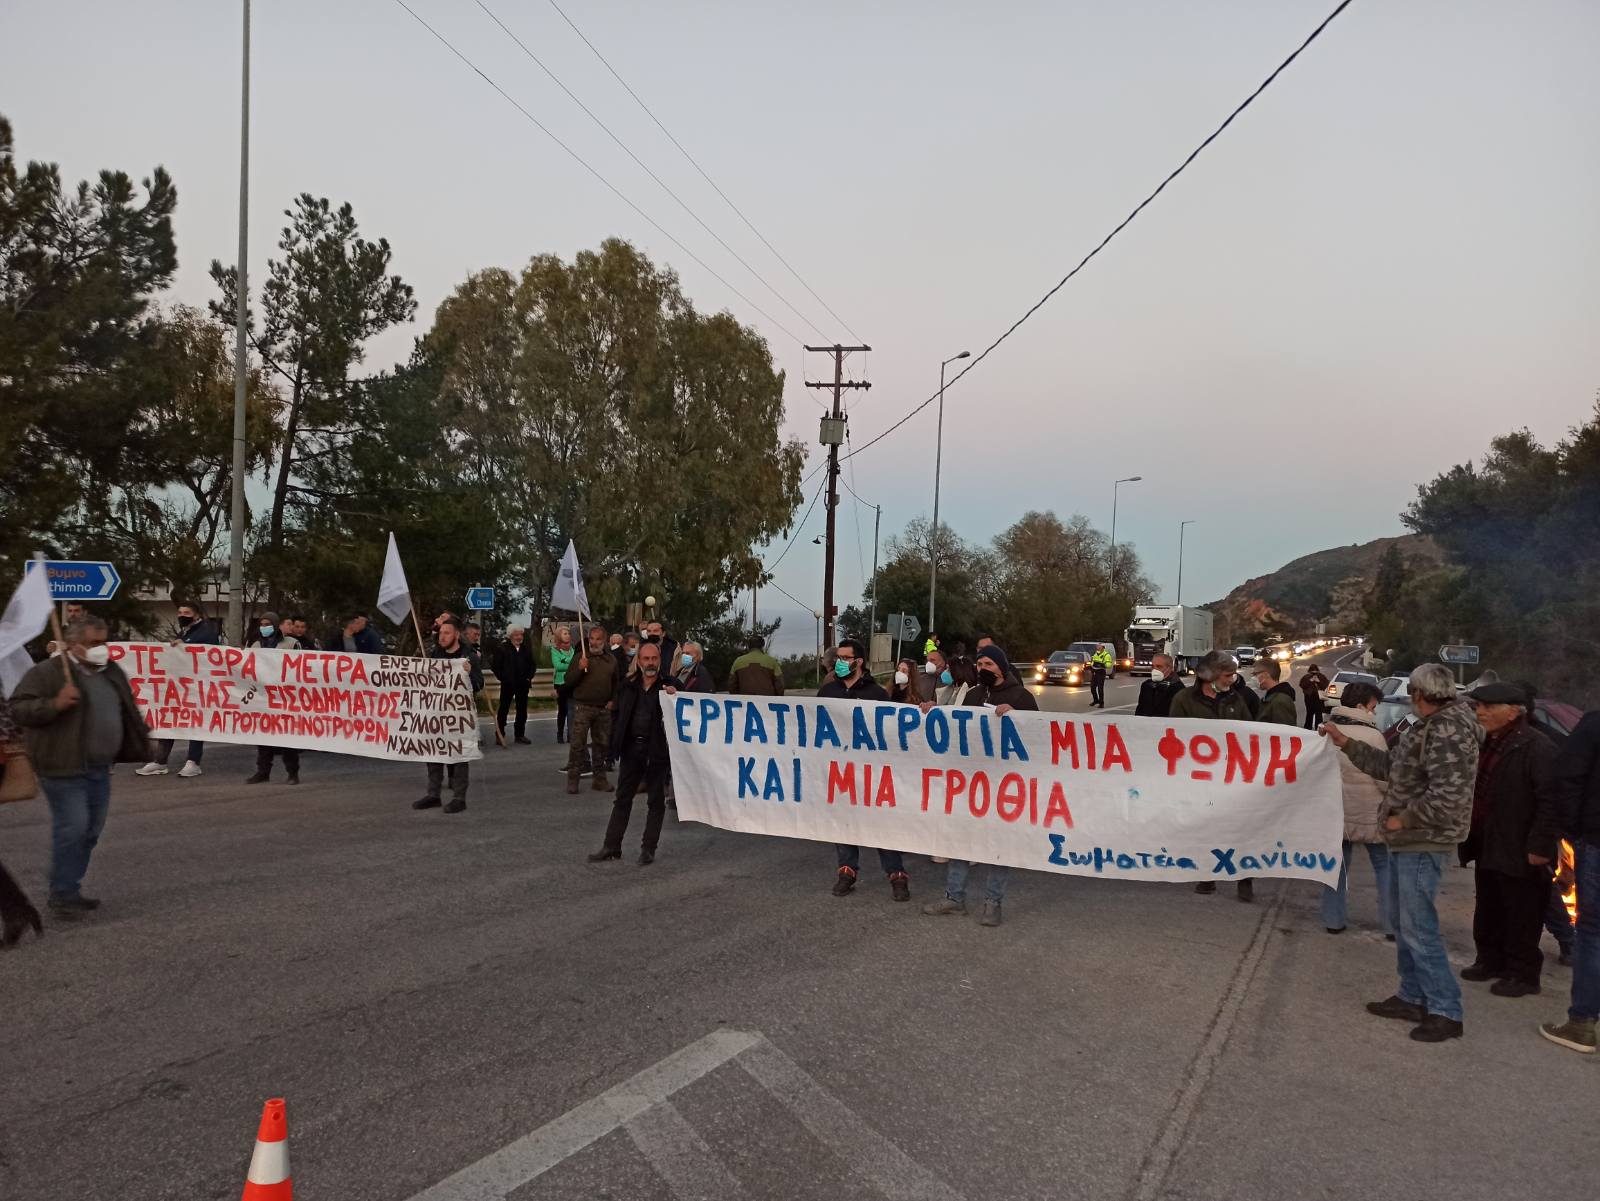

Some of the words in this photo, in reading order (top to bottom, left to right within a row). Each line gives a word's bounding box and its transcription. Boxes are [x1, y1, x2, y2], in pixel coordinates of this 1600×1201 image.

[185, 647, 257, 682] ΤΩΡΑ
[281, 653, 369, 685] ΜΕΤΡΑ
[371, 671, 467, 691] ΟΜΟΣΠΟΝΔΙΑ
[380, 656, 452, 674] ΕΝΩΤΙΚΗ
[129, 677, 240, 709] ΣΤΑΣΙΑΣ
[264, 685, 401, 719] ΕΙΣΟΔΗΜΑΤΟΣ
[400, 690, 476, 711] ΑΓΡΟΤΙΚΩΝ
[1050, 720, 1133, 772] ΜΙΑ
[1158, 728, 1302, 786] ΦΩΝΗ
[738, 757, 801, 802] ΚΑΙ
[827, 761, 896, 807] ΜΙΑ
[921, 768, 1074, 829] ΓΡΟΘΙΑ
[1210, 841, 1337, 876] Χανίων
